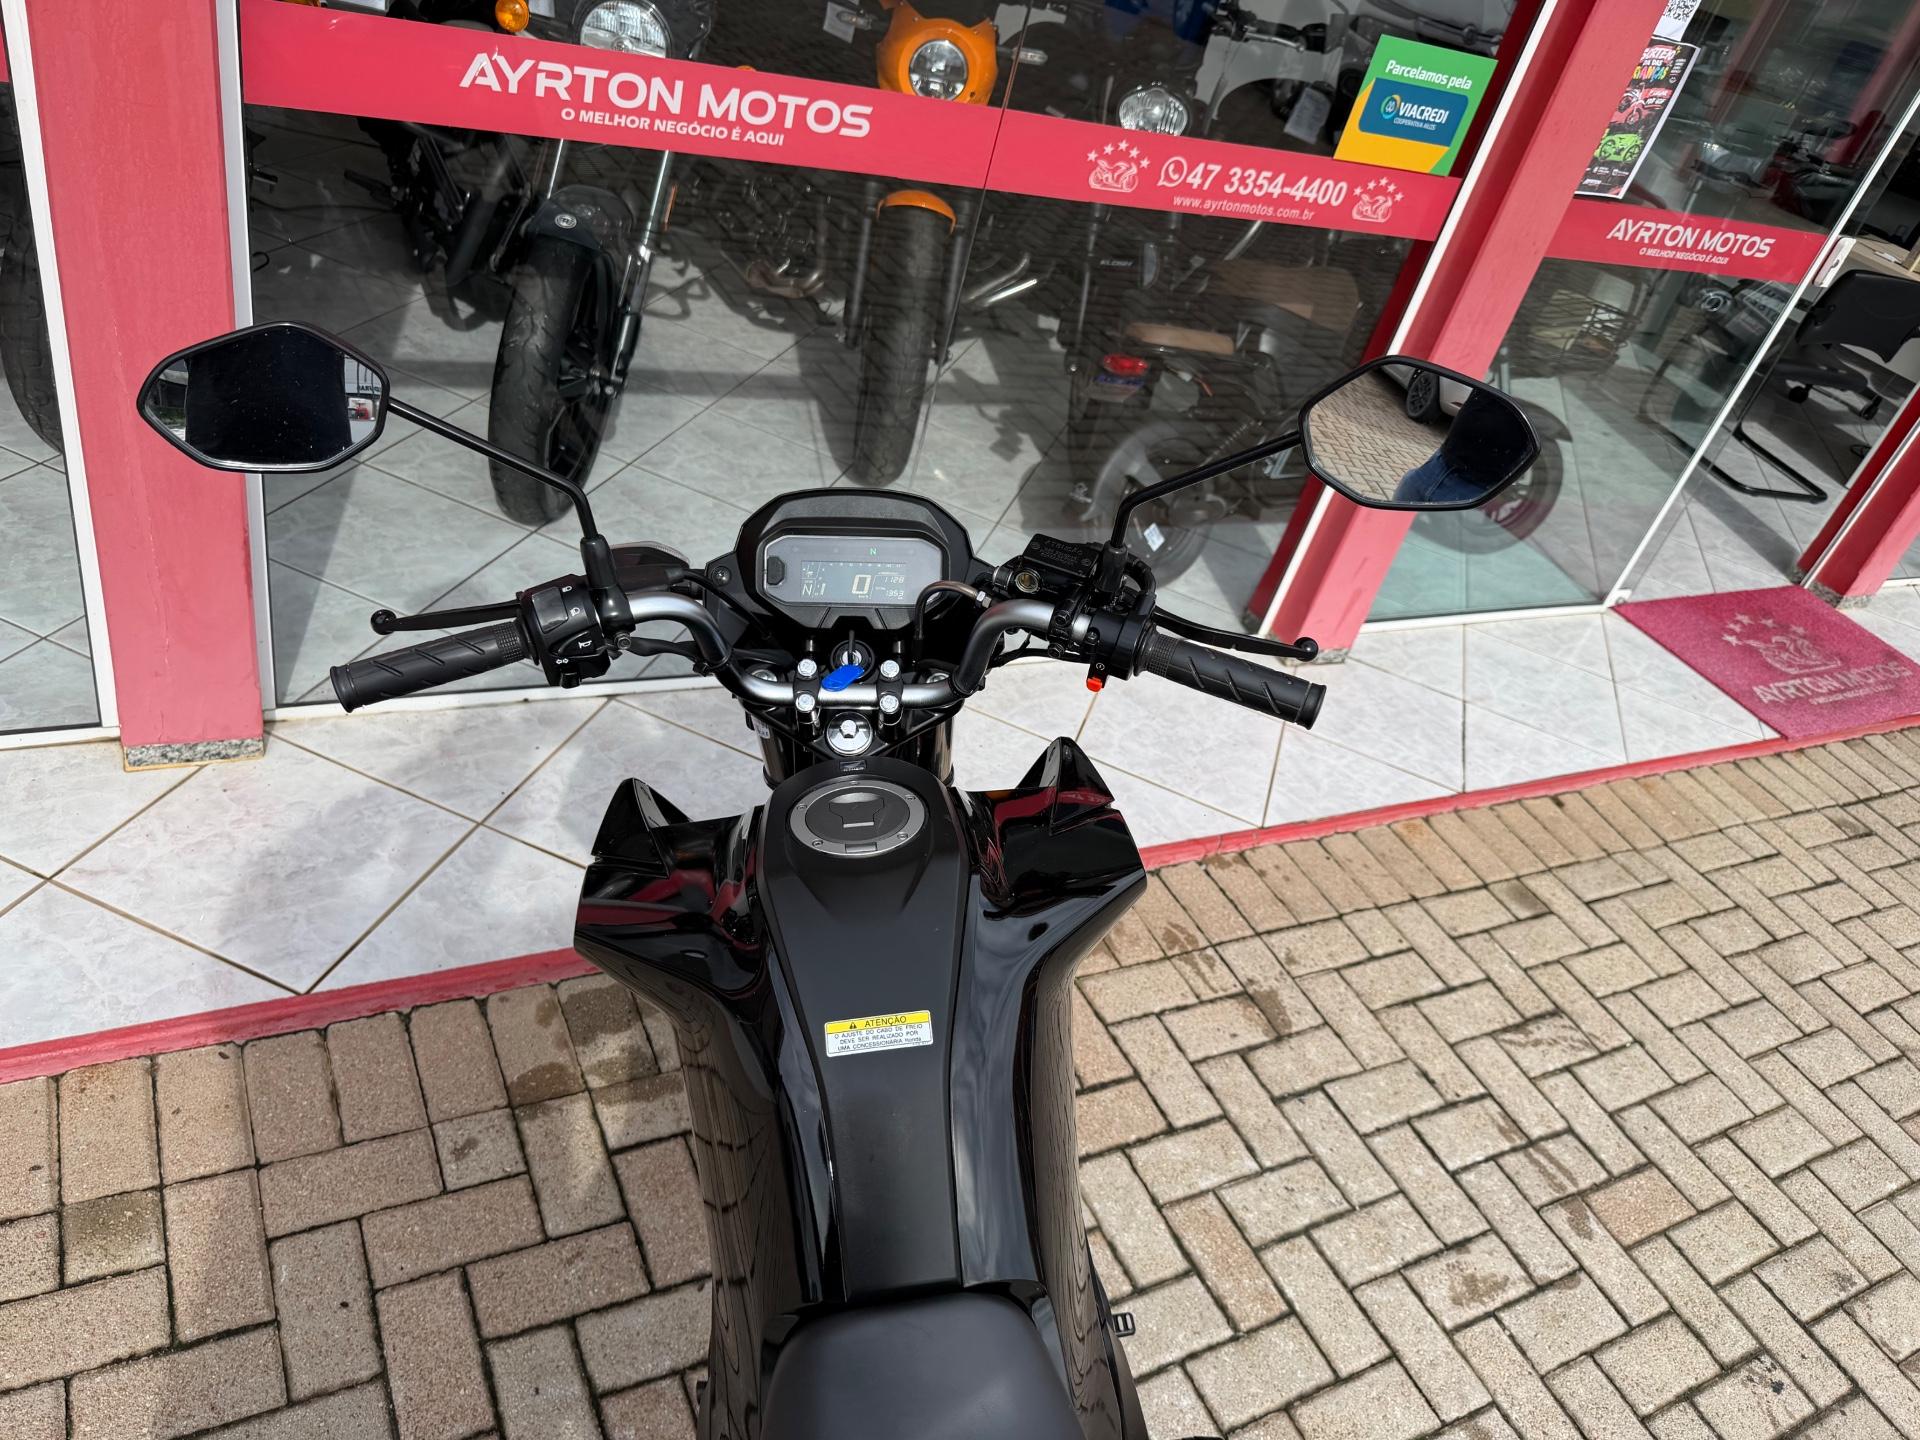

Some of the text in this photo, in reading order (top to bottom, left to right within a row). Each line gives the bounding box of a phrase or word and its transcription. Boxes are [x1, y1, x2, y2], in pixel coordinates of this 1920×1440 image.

[1385, 59, 1473, 90] Parcelamos pela
[459, 51, 873, 138] AYRTON MOTOS
[1399, 102, 1450, 124] VIACREDI
[561, 108, 784, 146] O MELHOR NEGÓCIO É AQUI
[1186, 162, 1348, 207] 47 3354-4400
[1173, 195, 1315, 220] www.ayrtonmotos.com.br
[1606, 218, 1776, 258] AYRTON MOTOS
[1646, 248, 1675, 259] MELHOR
[1674, 250, 1706, 262] NEGÓCIO
[1711, 256, 1729, 265] AQUI
[802, 583, 813, 596] N
[851, 574, 872, 594] 0
[1752, 674, 1845, 705] AYRTON
[1834, 662, 1914, 687] MOTOS
[864, 1015, 907, 1028] ATENÇÃO
[841, 1030, 864, 1038] AJUSTE
[872, 1032, 904, 1040] REALIZADO
